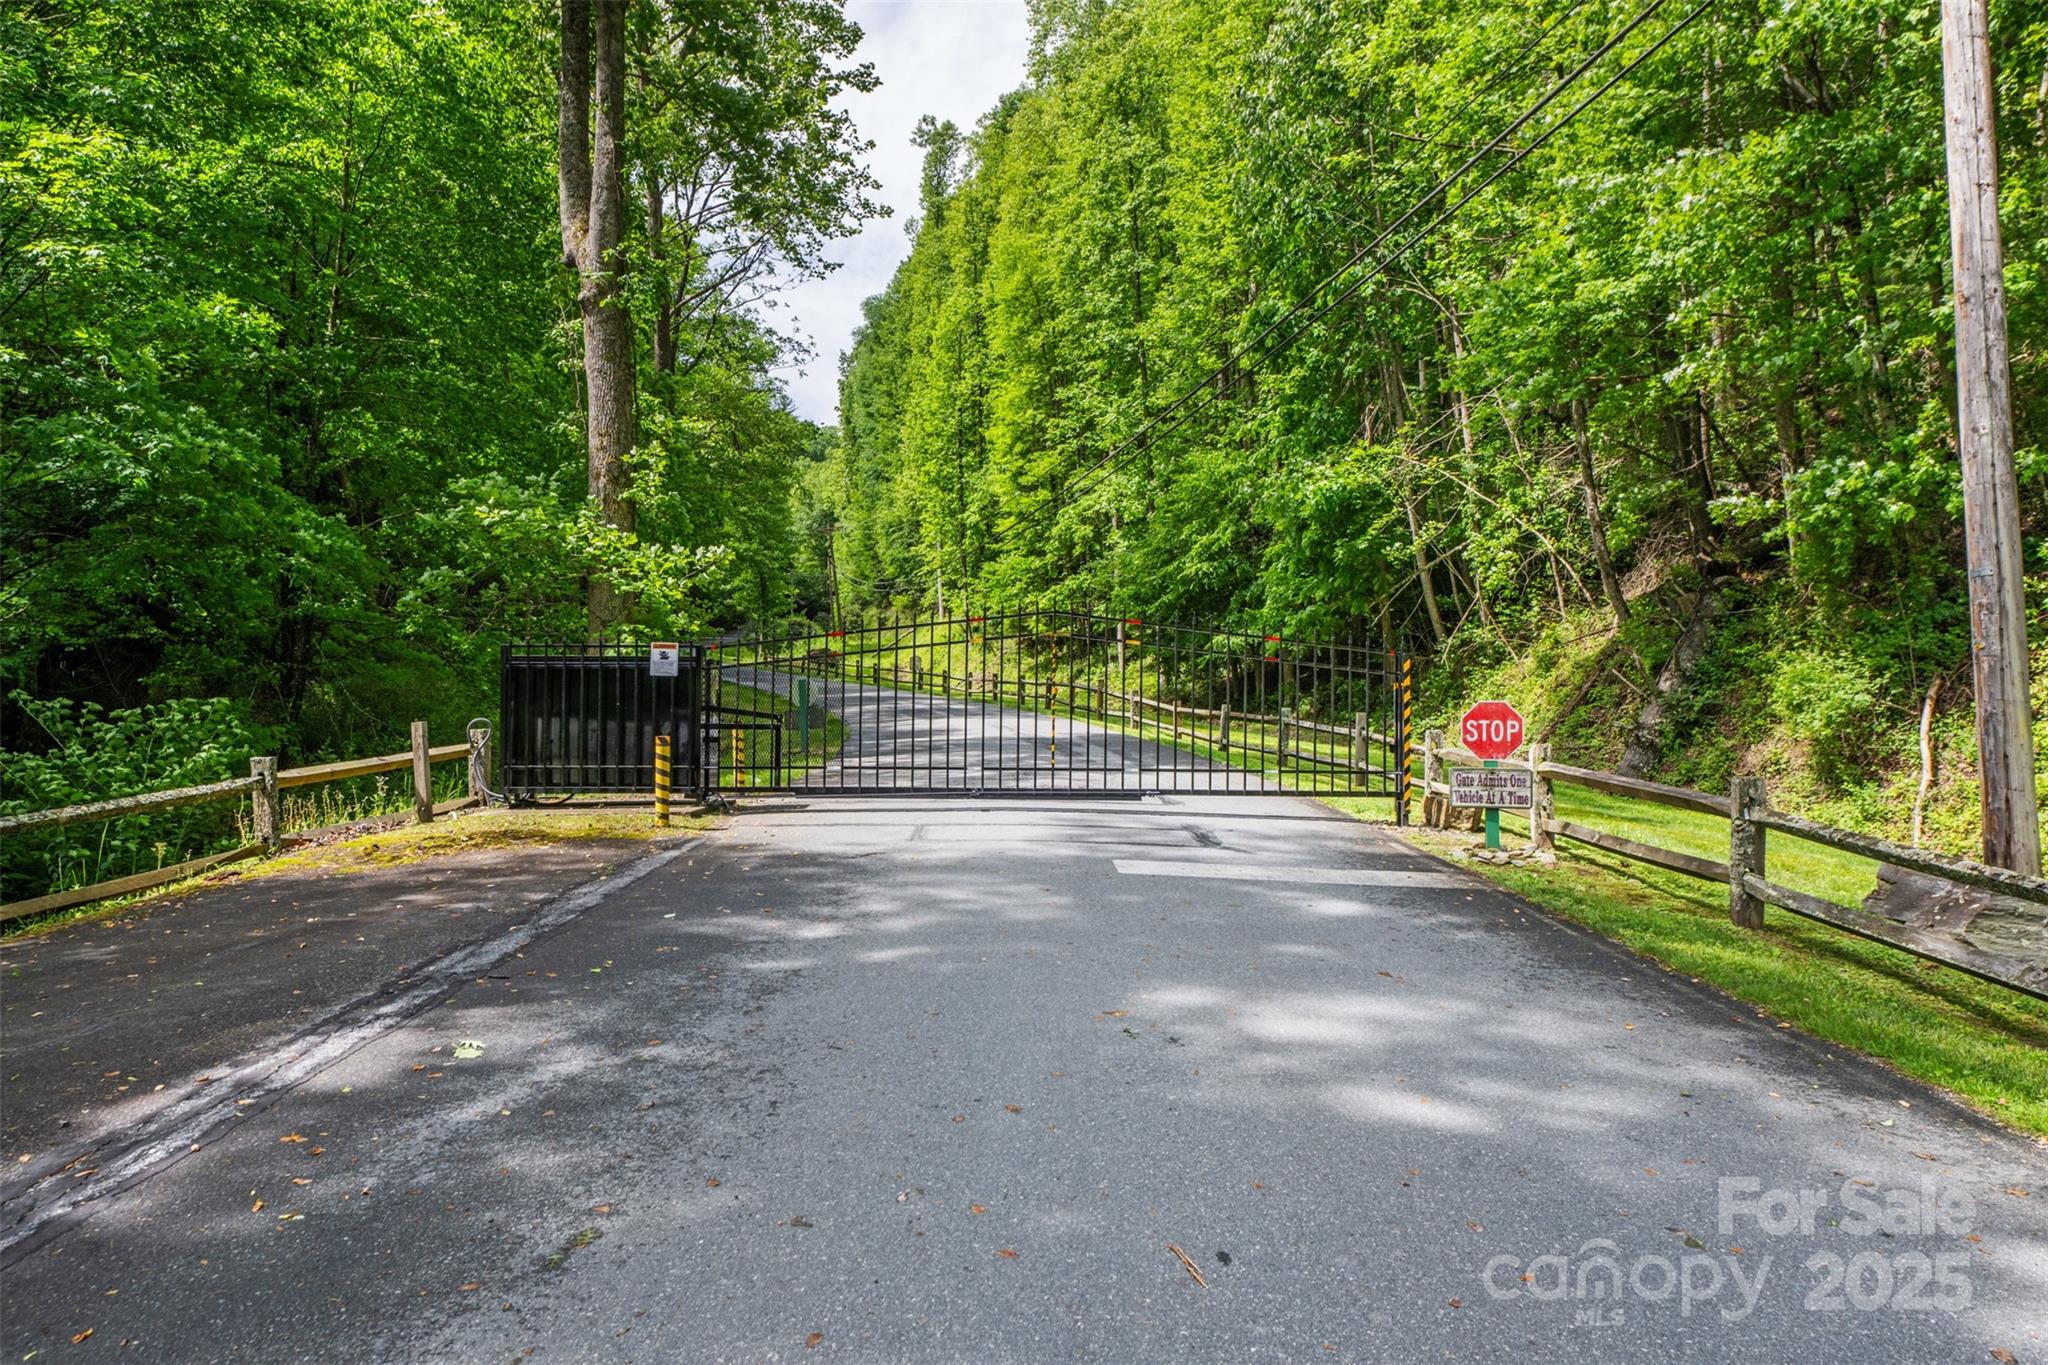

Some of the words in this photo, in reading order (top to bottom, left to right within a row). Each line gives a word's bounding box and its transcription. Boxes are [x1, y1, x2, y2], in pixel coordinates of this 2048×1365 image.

[1466, 720, 1519, 742] STOP
[1455, 773, 1474, 787] Gate
[1477, 774, 1507, 787] Admits
[1510, 775, 1527, 787] One
[1455, 790, 1483, 804] Vehicle
[1486, 791, 1496, 804] At
[1498, 791, 1505, 804] A
[1508, 792, 1529, 805] Time
